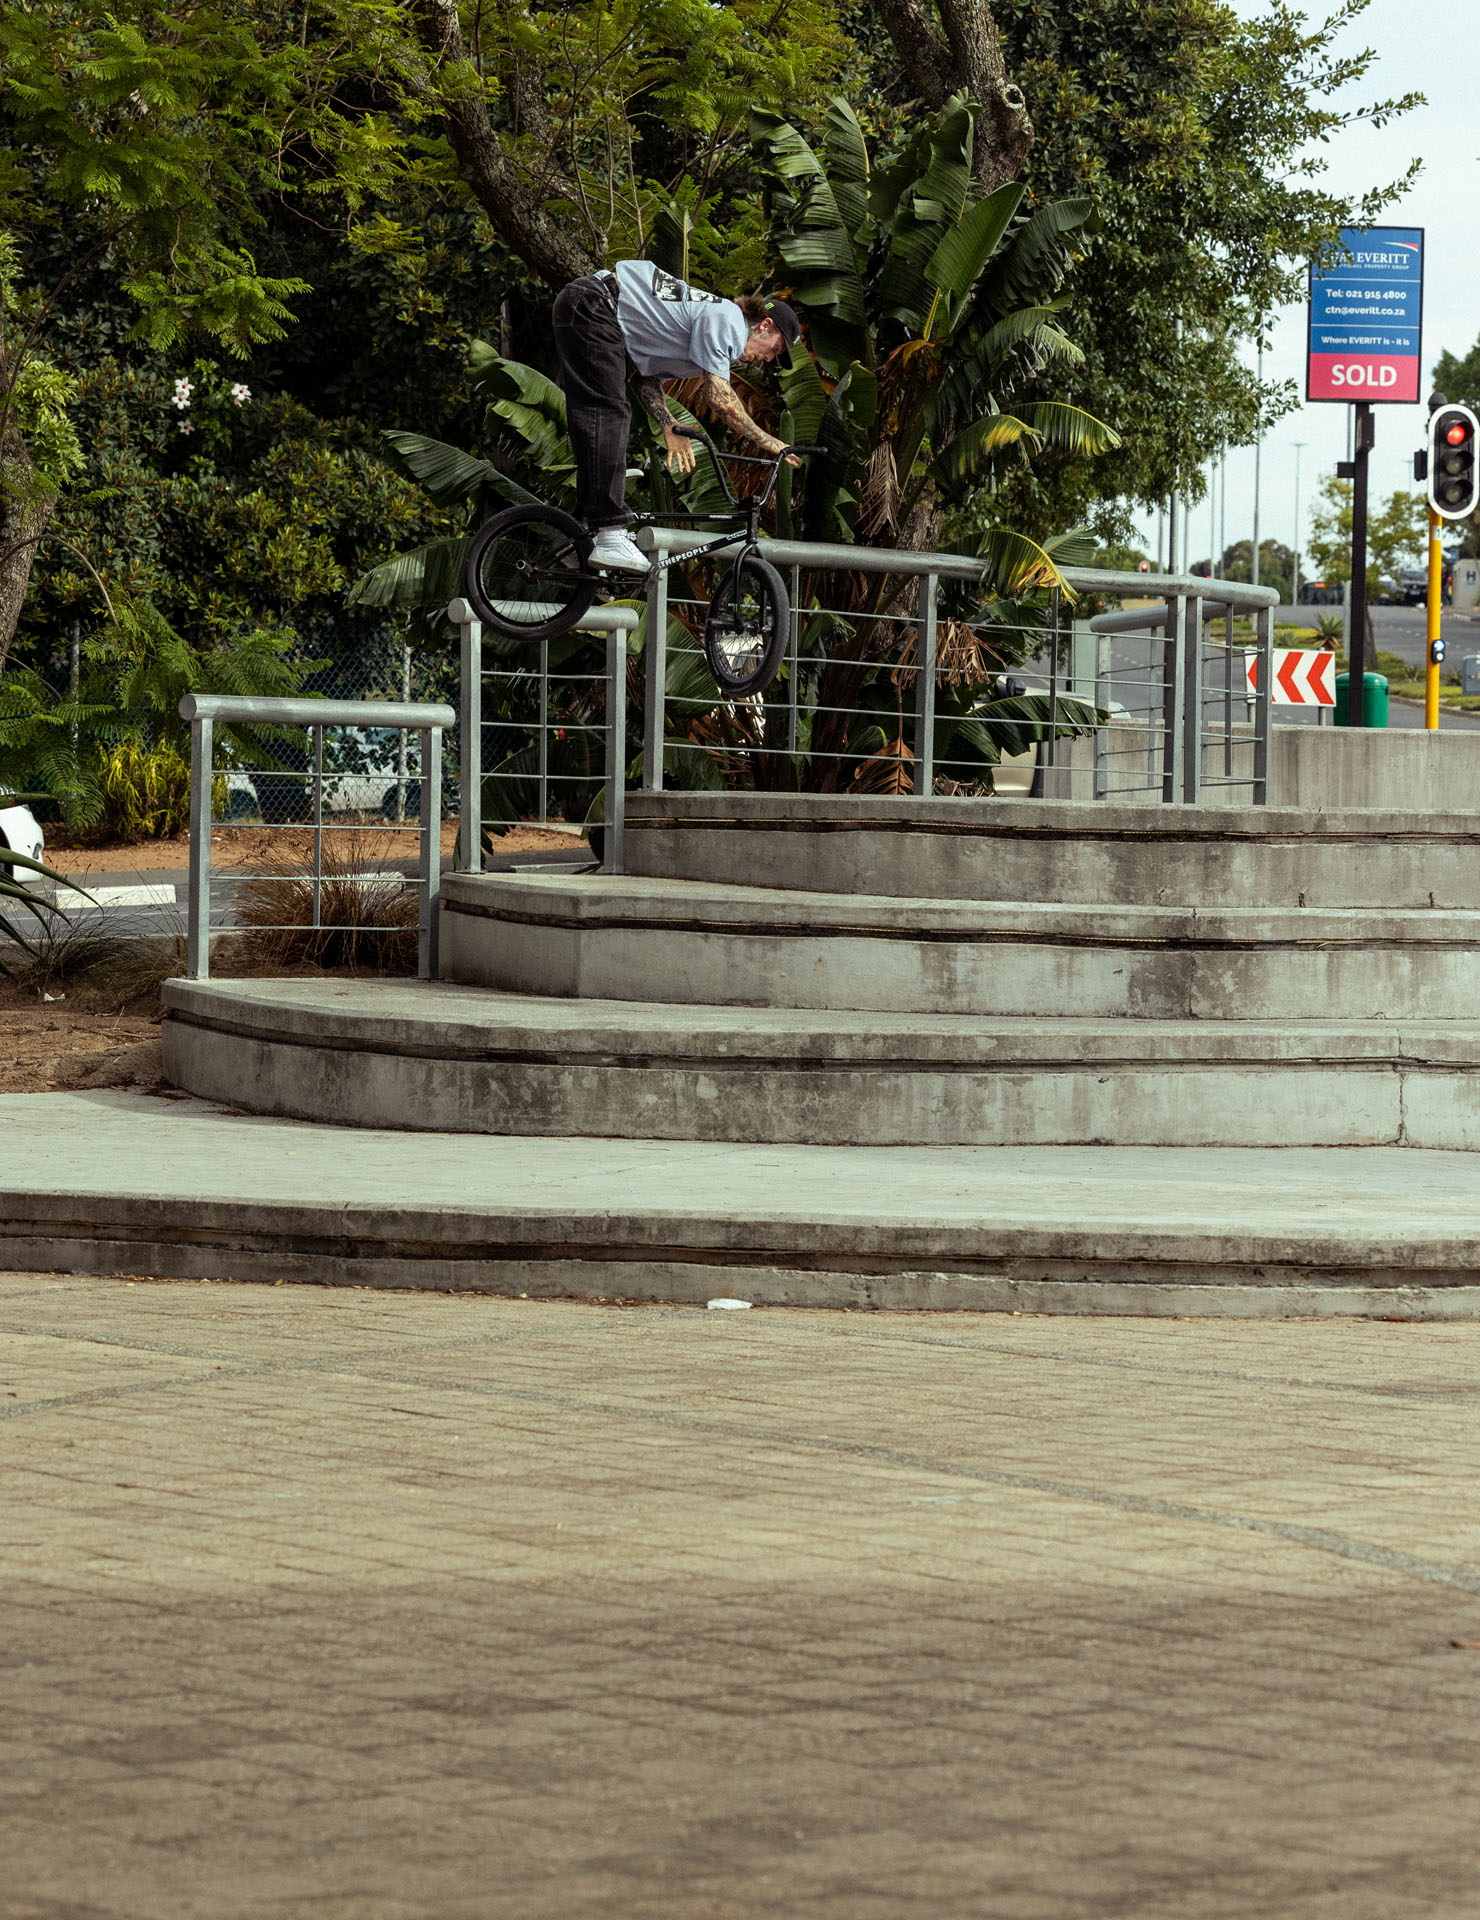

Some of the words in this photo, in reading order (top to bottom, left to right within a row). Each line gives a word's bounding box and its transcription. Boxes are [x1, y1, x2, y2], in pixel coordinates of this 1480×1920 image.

[1357, 252, 1410, 265] EVERITT
[1325, 289, 1344, 298] Tel:
[1345, 290, 1363, 299] 021
[1364, 290, 1381, 300] 915
[1382, 290, 1407, 300] 4800
[1325, 305, 1406, 316] ctn@everitt.co.za
[1321, 336, 1348, 344] Where
[1349, 336, 1382, 345] EVERITT
[1383, 337, 1390, 345] is
[1396, 338, 1402, 346] it
[1403, 338, 1410, 346] is
[1331, 364, 1397, 387] SOLD
